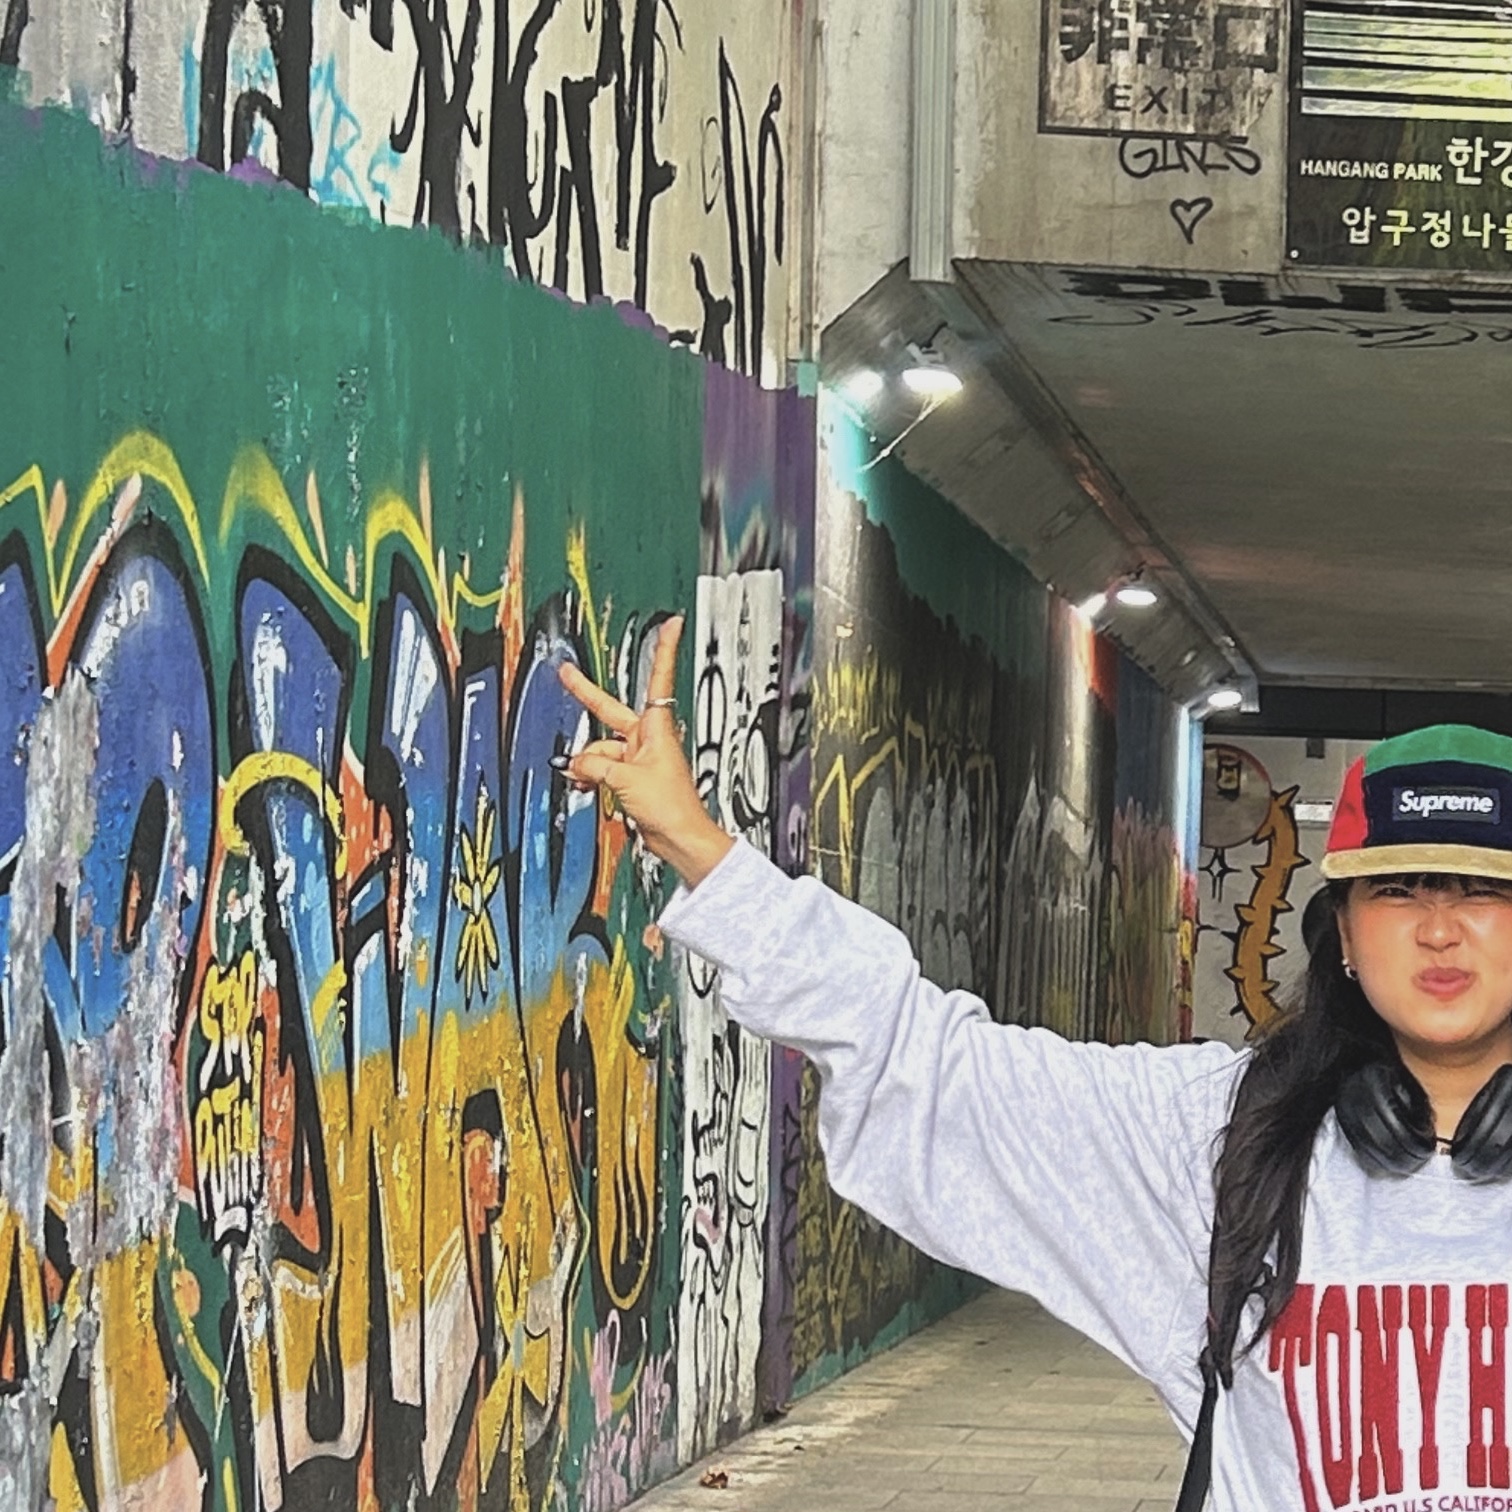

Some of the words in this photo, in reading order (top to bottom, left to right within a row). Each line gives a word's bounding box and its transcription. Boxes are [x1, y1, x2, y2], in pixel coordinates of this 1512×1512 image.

[1107, 84, 1223, 115] EXIT
[1300, 159, 1389, 180] HANGANG
[1393, 162, 1443, 182] PARK
[1399, 790, 1494, 817] Supreme
